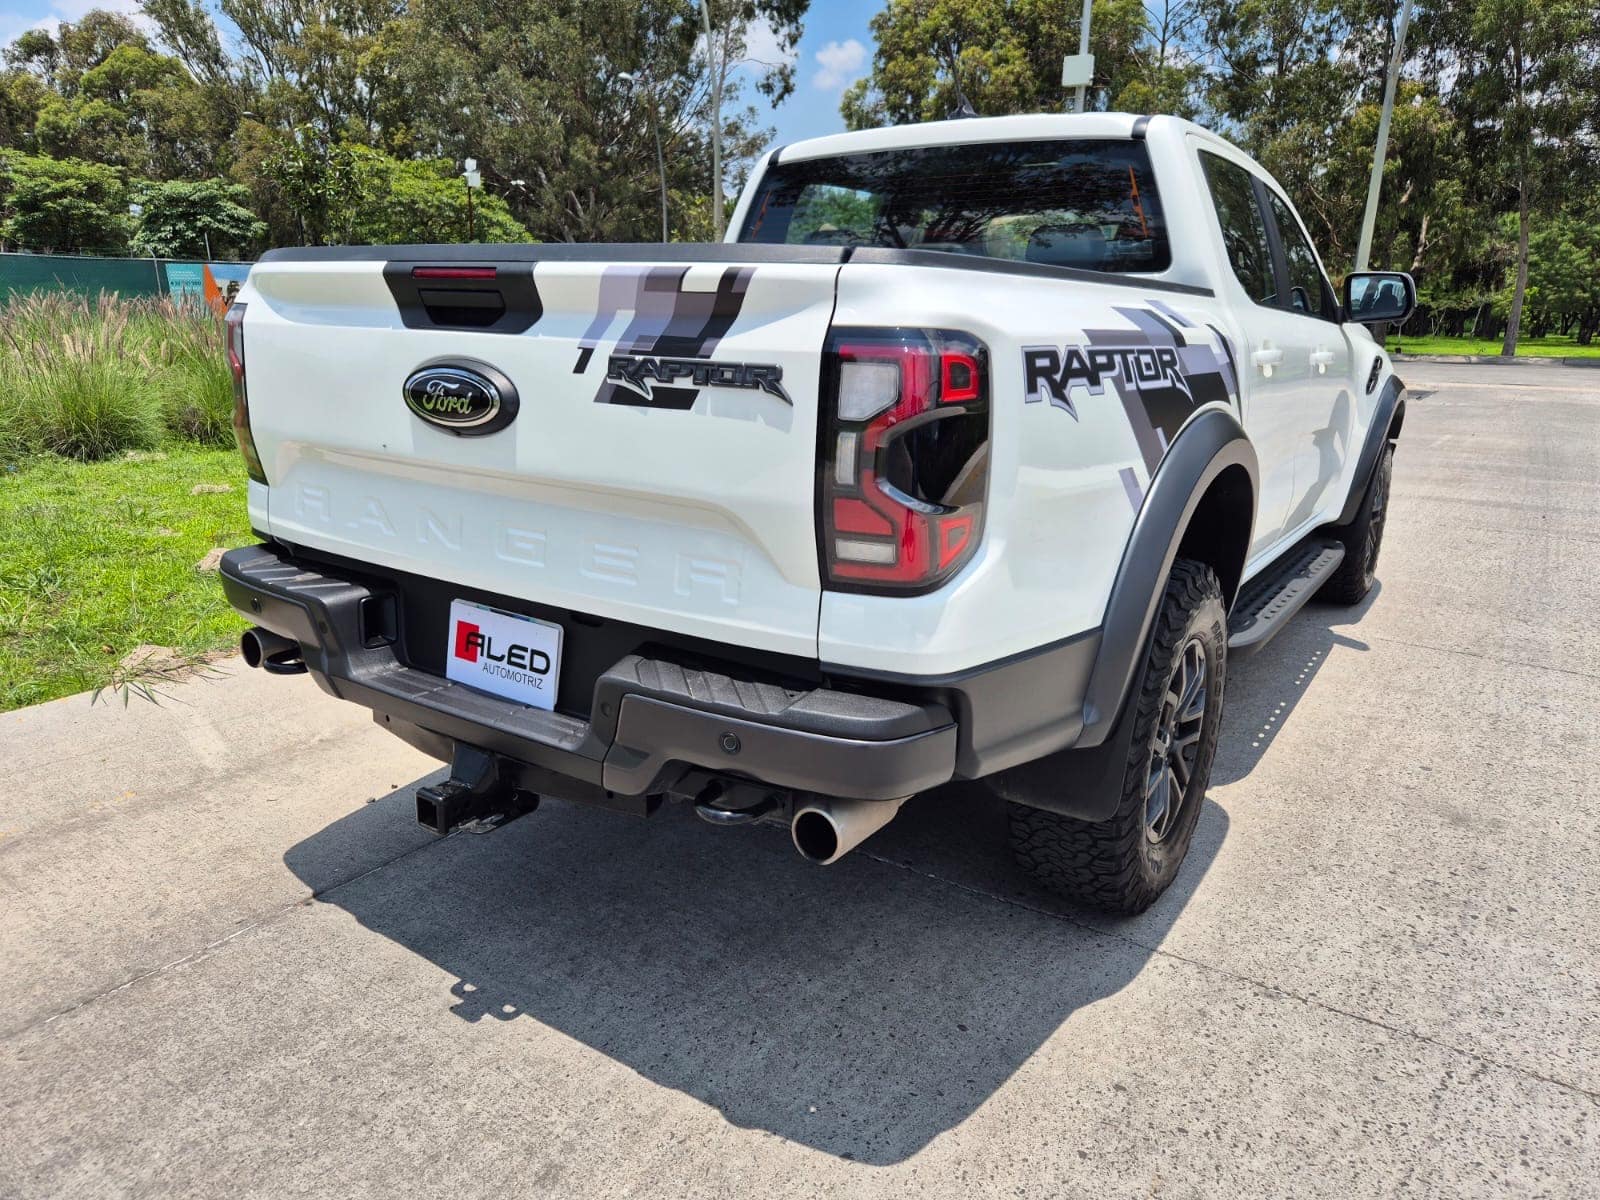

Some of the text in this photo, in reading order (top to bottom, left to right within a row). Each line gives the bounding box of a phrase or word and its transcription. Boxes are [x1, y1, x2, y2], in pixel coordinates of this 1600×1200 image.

[422, 379, 473, 415] Ford
[607, 355, 794, 407] RAPTOR
[1021, 345, 1195, 422] RAPTOR
[295, 480, 743, 606] RANGER
[464, 631, 551, 675] ALED
[482, 662, 543, 690] AUTOMOTRIZ
